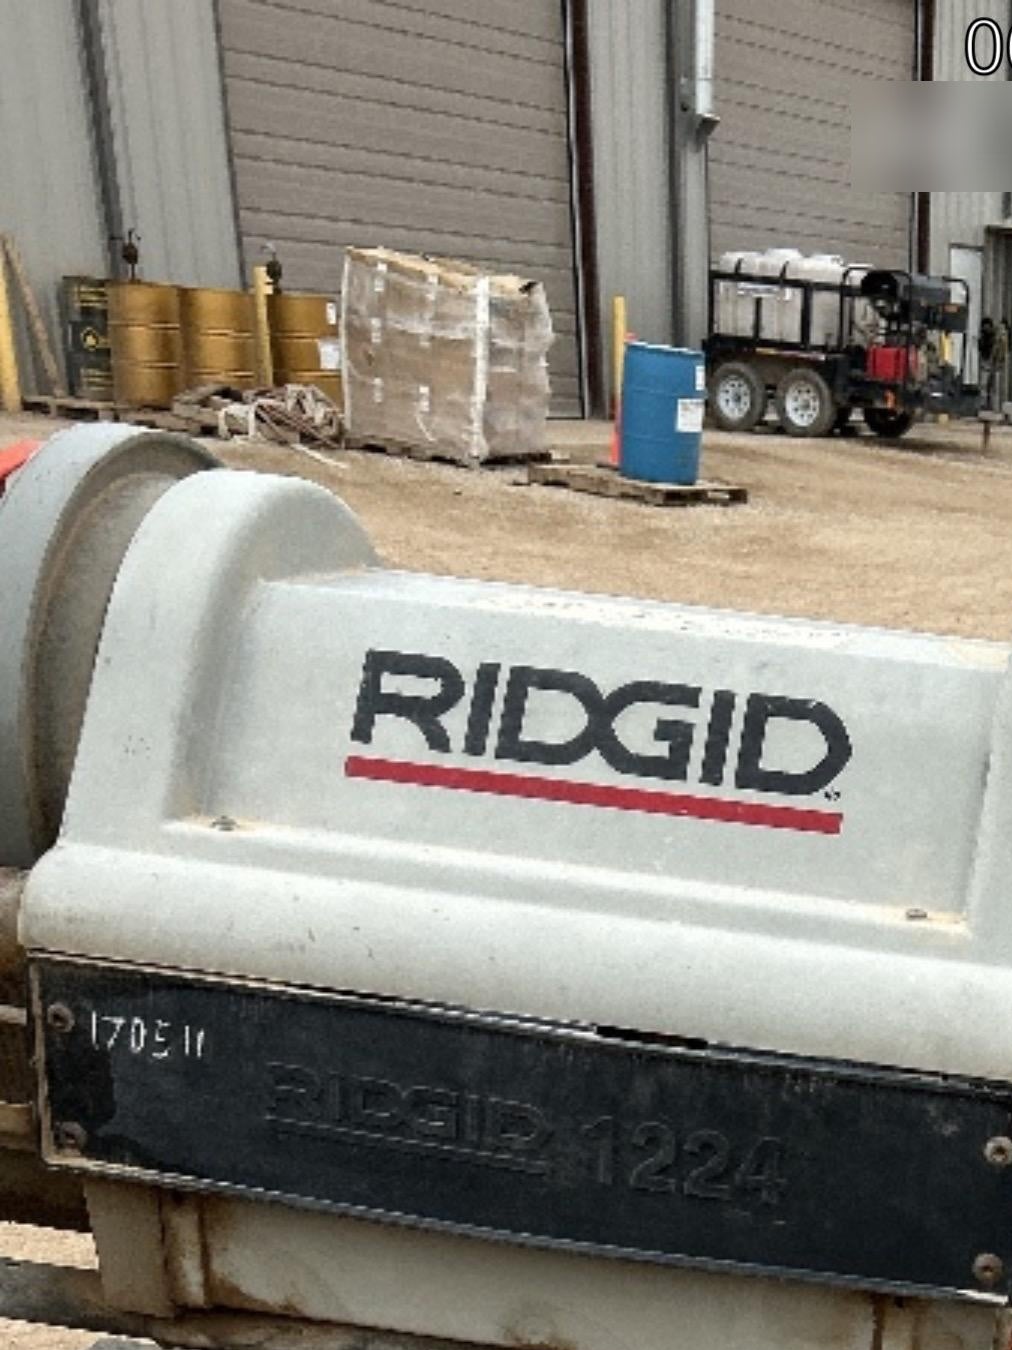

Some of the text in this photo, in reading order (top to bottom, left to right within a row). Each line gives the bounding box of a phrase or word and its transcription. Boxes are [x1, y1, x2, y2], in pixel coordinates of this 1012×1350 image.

[350, 647, 853, 796] RIDGID
[264, 1060, 789, 1205] RIDGID 1224
